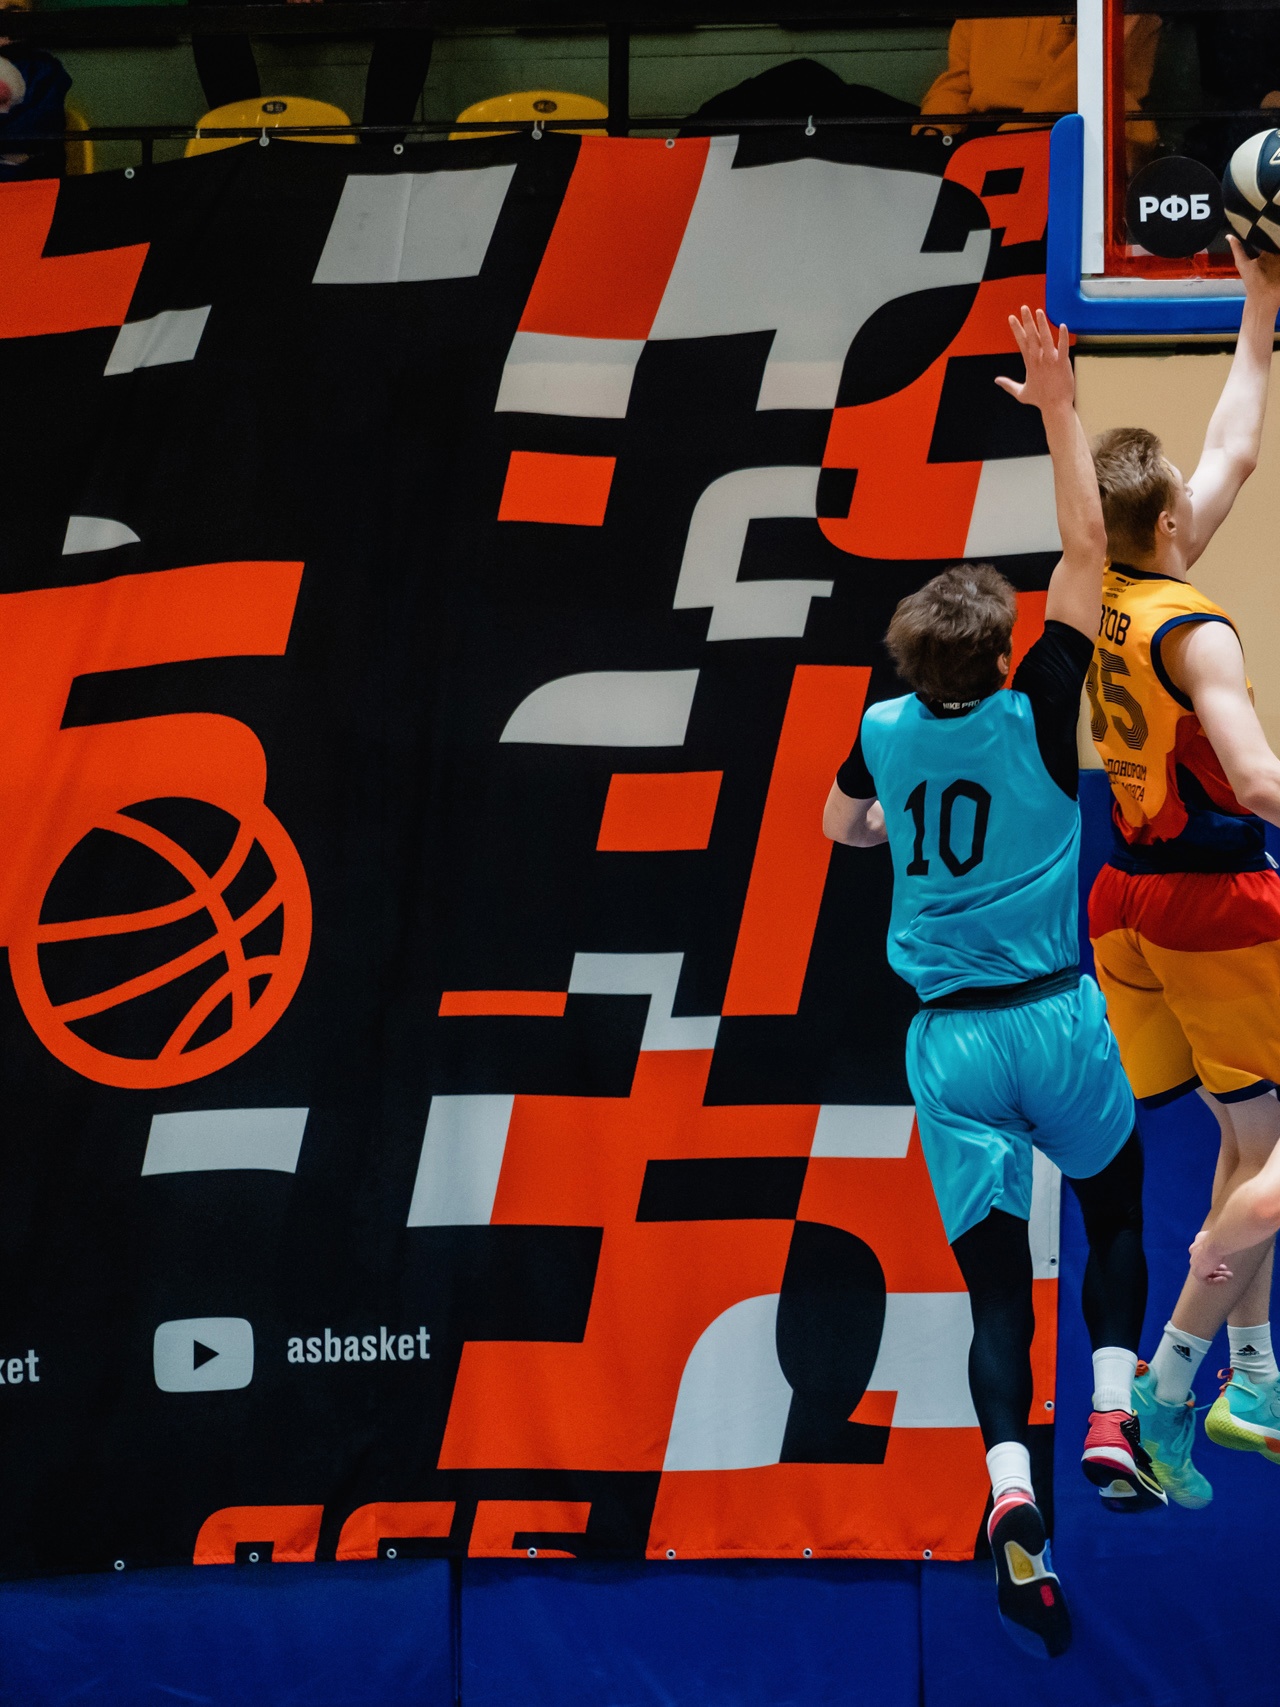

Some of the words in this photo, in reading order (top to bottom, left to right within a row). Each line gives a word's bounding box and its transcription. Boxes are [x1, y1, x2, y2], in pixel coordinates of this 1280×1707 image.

[1139, 194, 1211, 222] РФБ
[904, 778, 992, 877] 10
[287, 1326, 431, 1364] asbasket
